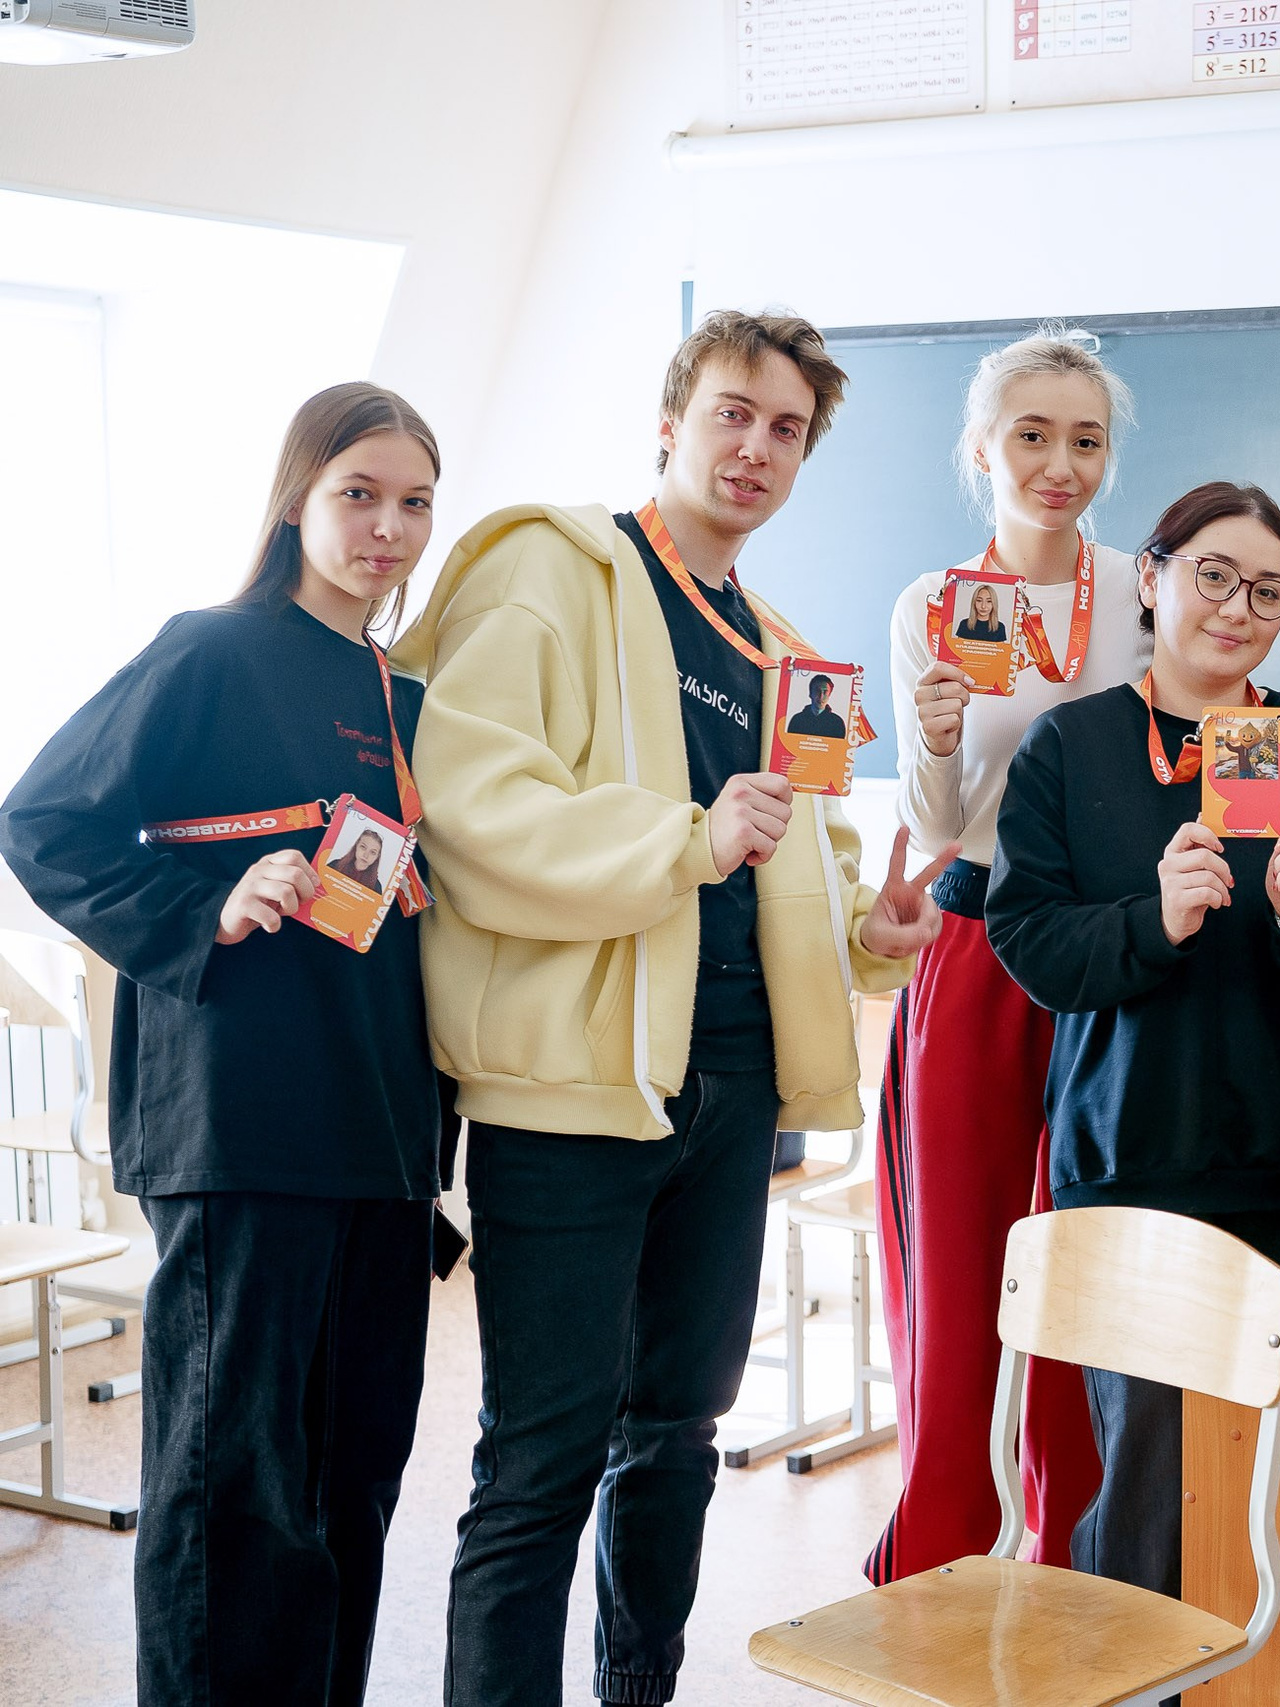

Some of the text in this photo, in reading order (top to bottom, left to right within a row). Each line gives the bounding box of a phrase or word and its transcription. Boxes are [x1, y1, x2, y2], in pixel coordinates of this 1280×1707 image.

[1240, 5, 1278, 23] 2187
[1238, 30, 1277, 49] 3125
[1239, 57, 1266, 75] 512
